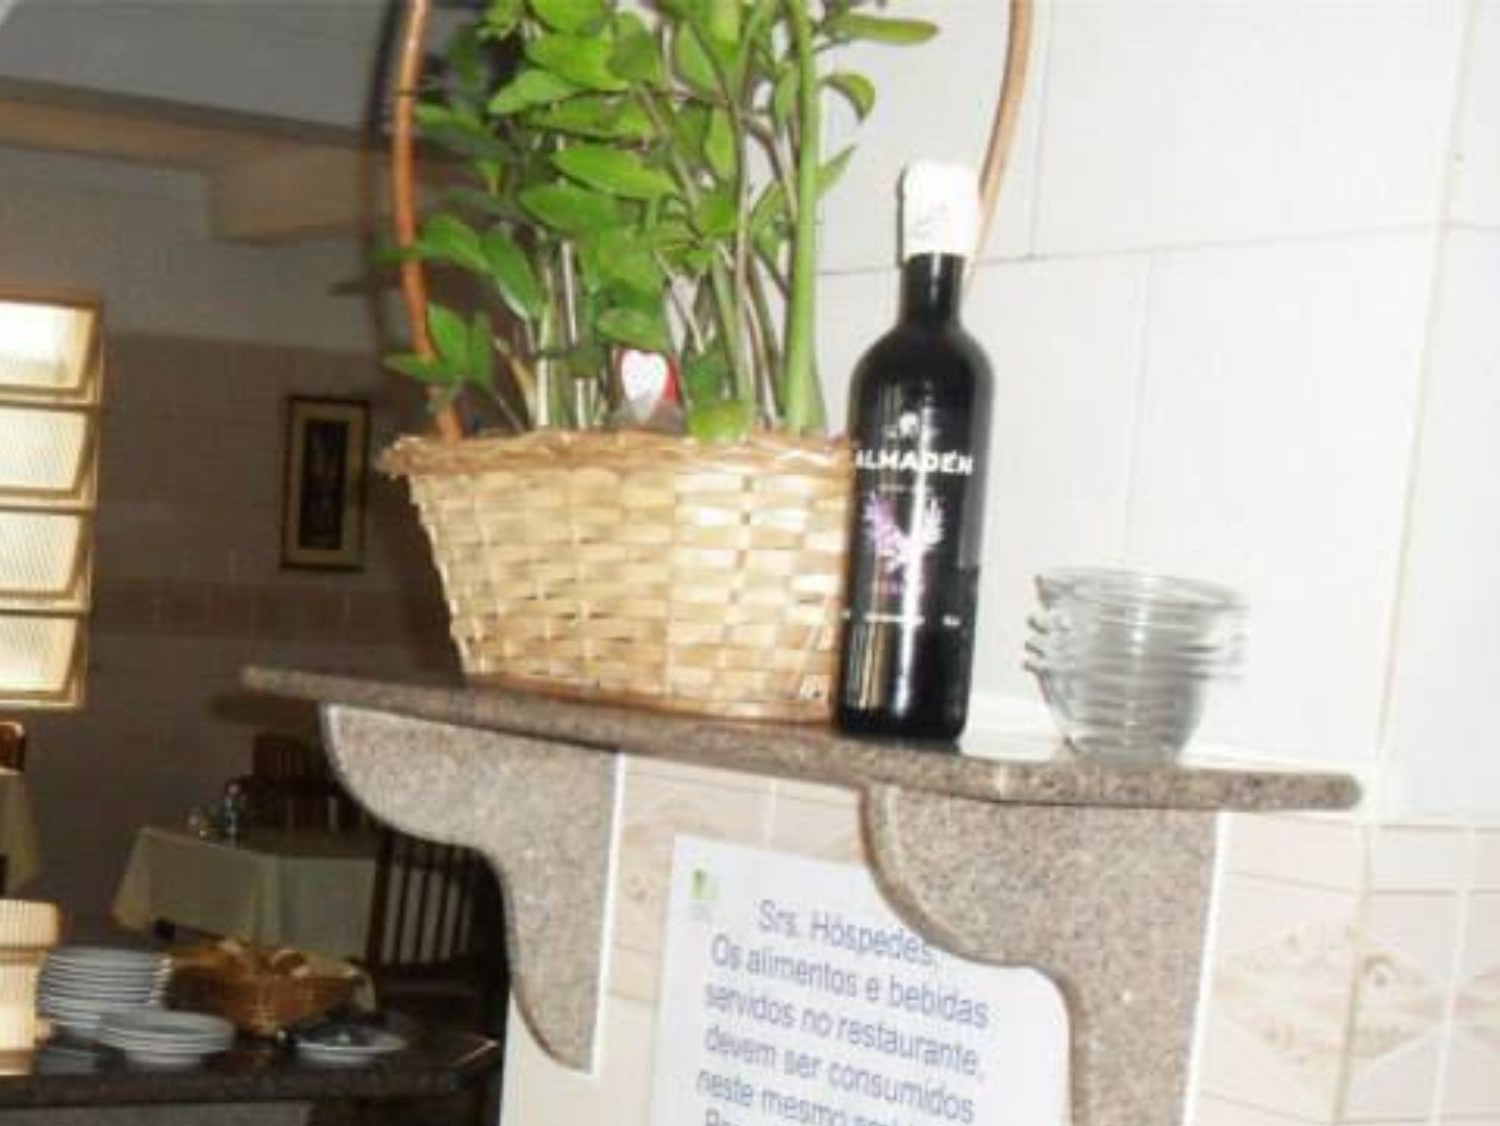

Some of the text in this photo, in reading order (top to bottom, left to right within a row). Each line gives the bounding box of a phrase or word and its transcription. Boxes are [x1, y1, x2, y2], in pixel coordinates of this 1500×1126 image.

[704, 984, 795, 1028] servidos
[802, 1008, 833, 1037] no
[711, 934, 989, 1029] Os alimentos e bebidas
[697, 1069, 754, 1107] neste
[704, 1025, 975, 1125] devem ser consumidos
